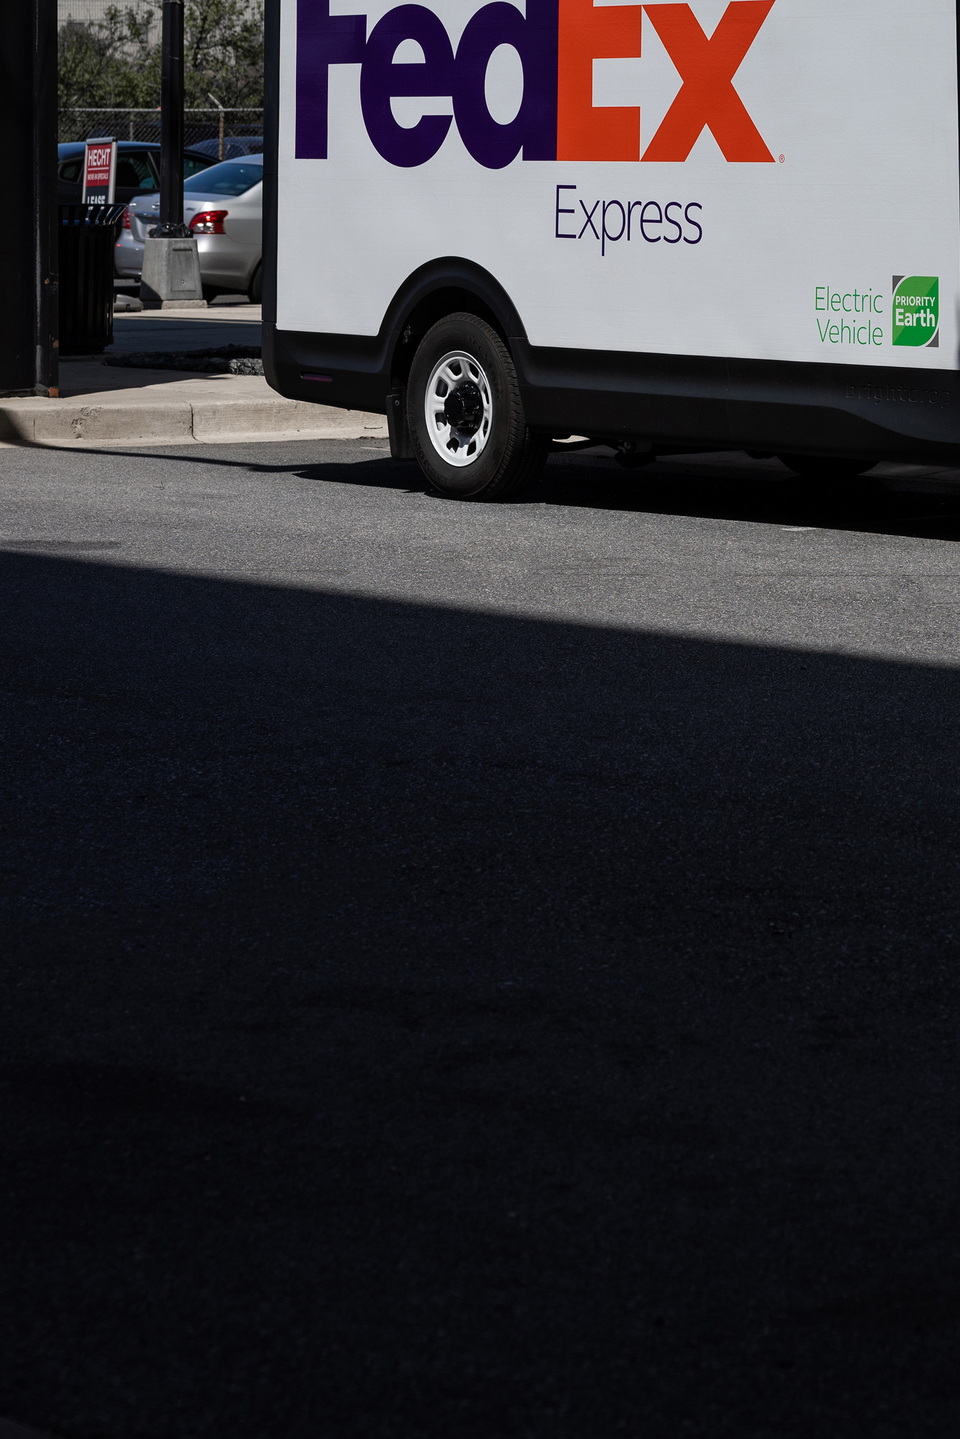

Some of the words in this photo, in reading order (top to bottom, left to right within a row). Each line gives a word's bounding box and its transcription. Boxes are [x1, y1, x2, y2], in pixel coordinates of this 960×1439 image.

[88, 148, 111, 166] HECHT
[554, 184, 704, 257] Express
[815, 285, 884, 314] Electric
[895, 295, 936, 307] PRIORITY
[895, 308, 936, 328] Earth
[816, 318, 884, 346] Vehicle
